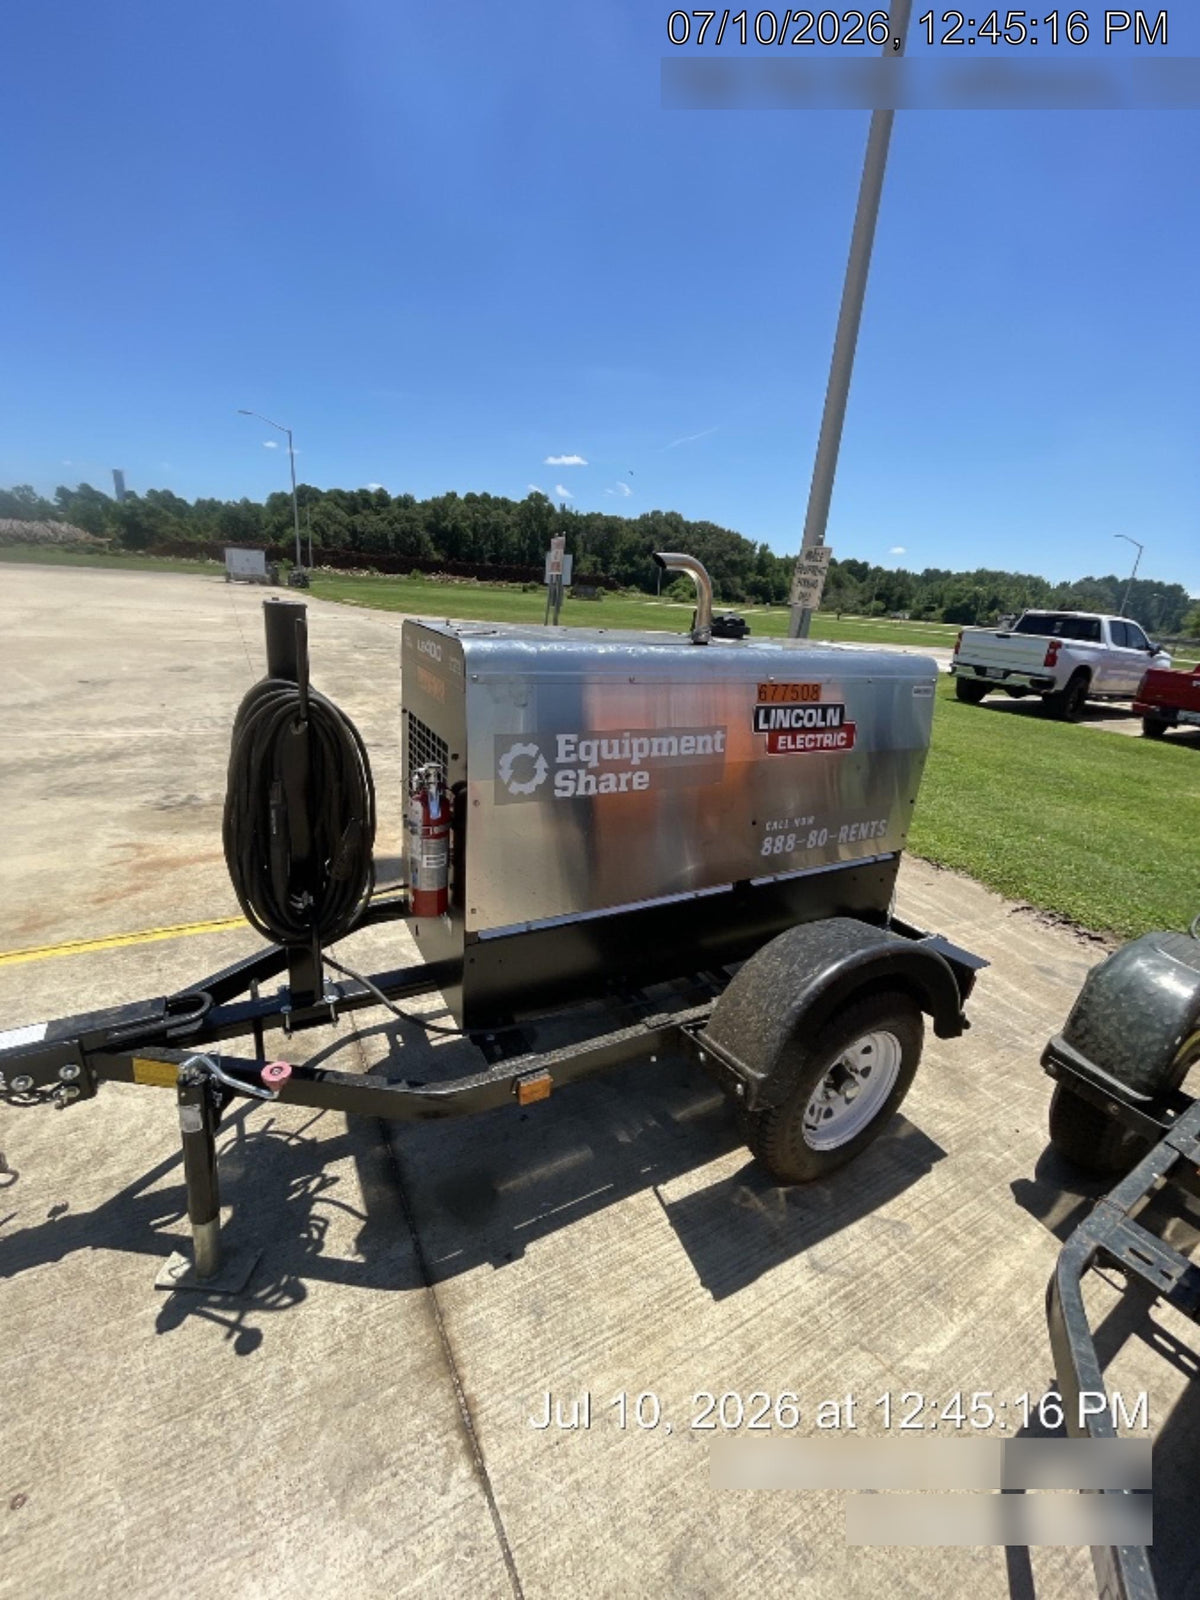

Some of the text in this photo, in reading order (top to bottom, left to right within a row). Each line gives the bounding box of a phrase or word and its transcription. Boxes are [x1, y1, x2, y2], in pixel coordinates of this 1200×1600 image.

[758, 683, 820, 701] 677508
[758, 706, 840, 730] LINCOLN
[555, 729, 726, 768] Equipment
[777, 732, 847, 750] ELECTRIC
[554, 768, 650, 798] Share
[760, 819, 887, 856] 888-80-RENTS
